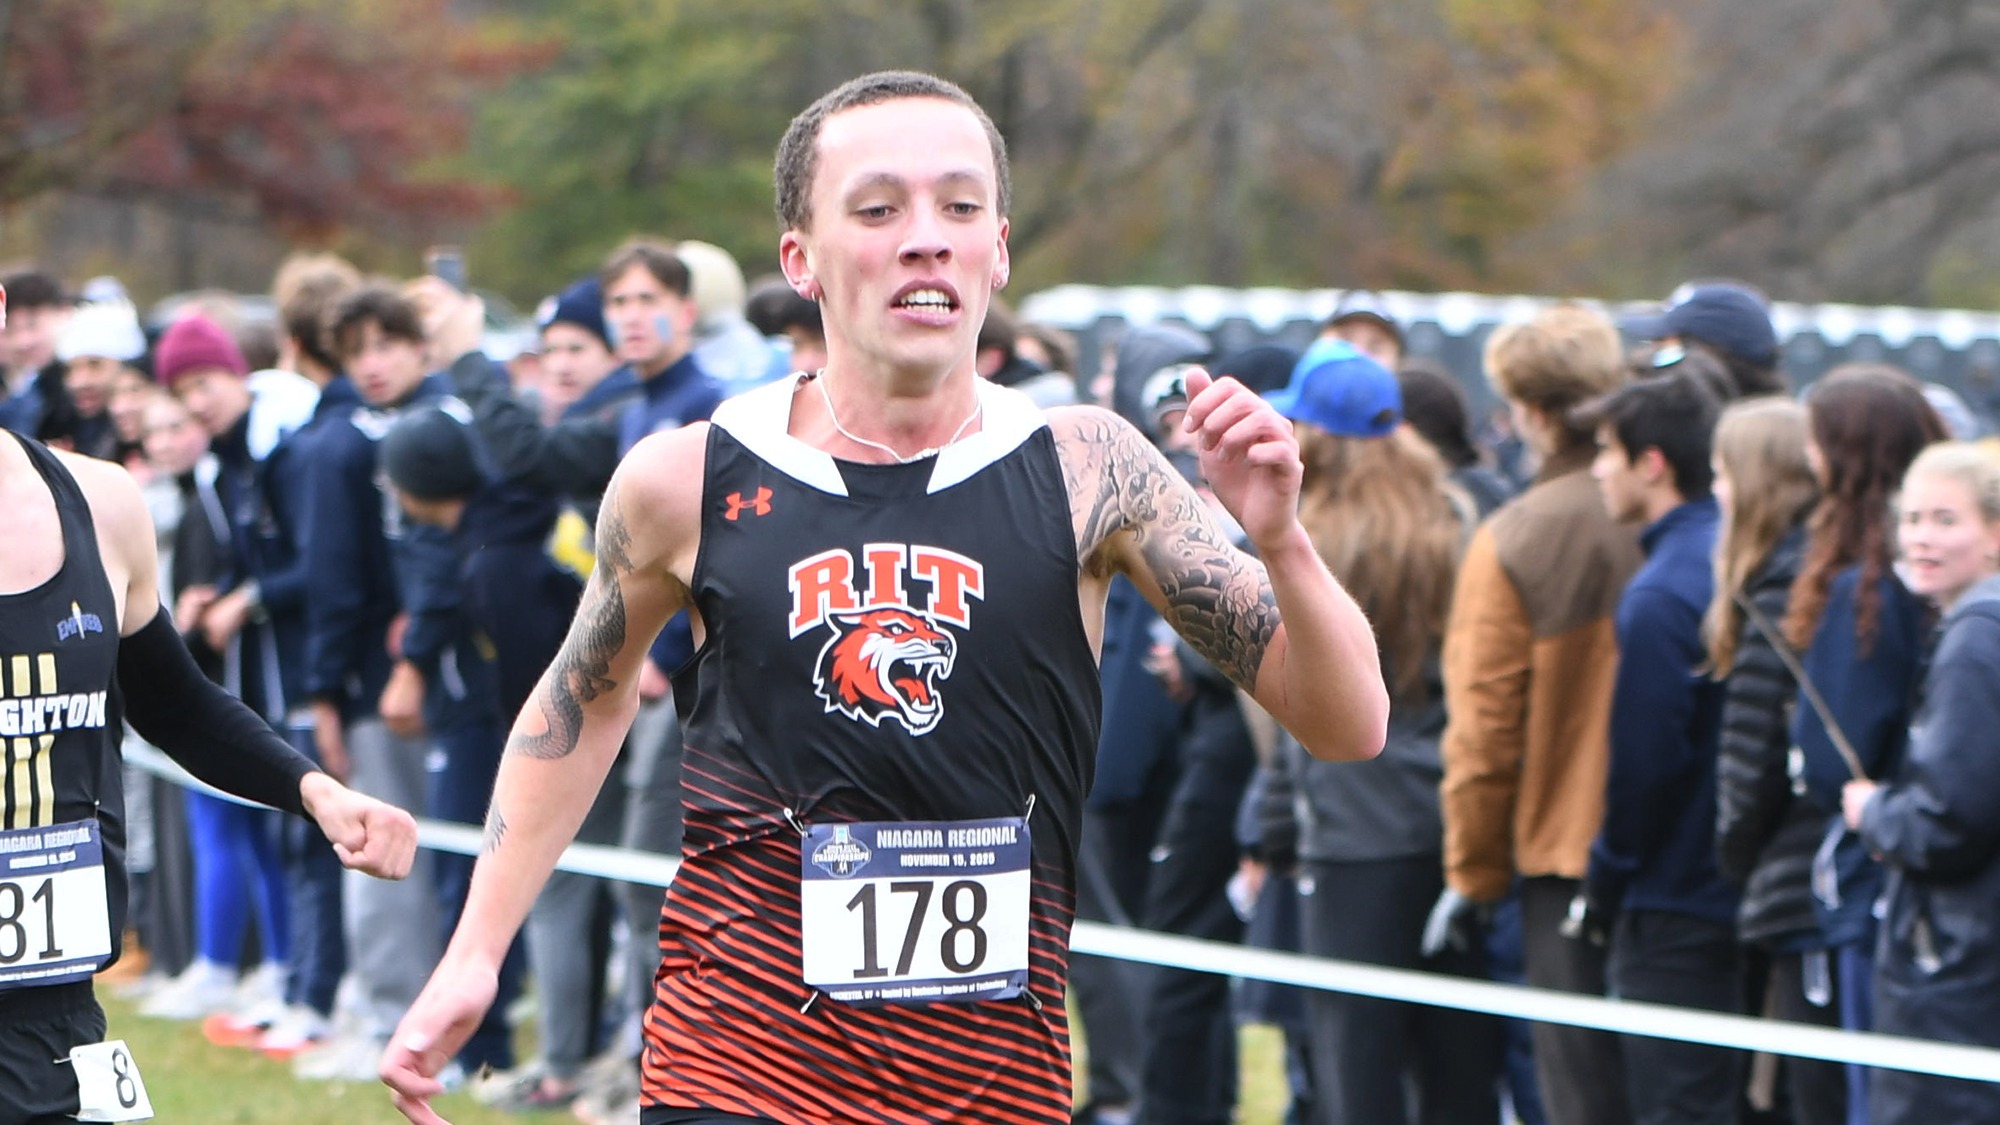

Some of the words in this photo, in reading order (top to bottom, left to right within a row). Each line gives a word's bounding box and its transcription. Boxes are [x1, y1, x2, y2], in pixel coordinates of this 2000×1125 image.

[788, 543, 984, 640] RIT
[877, 829, 943, 848] NIAGARA
[948, 826, 1017, 847] REGIONAL
[900, 853, 950, 867] NOVEMBER
[969, 852, 995, 866] 2025
[0, 877, 63, 964] 81
[846, 880, 988, 979] 178
[112, 1048, 137, 1109] 8
